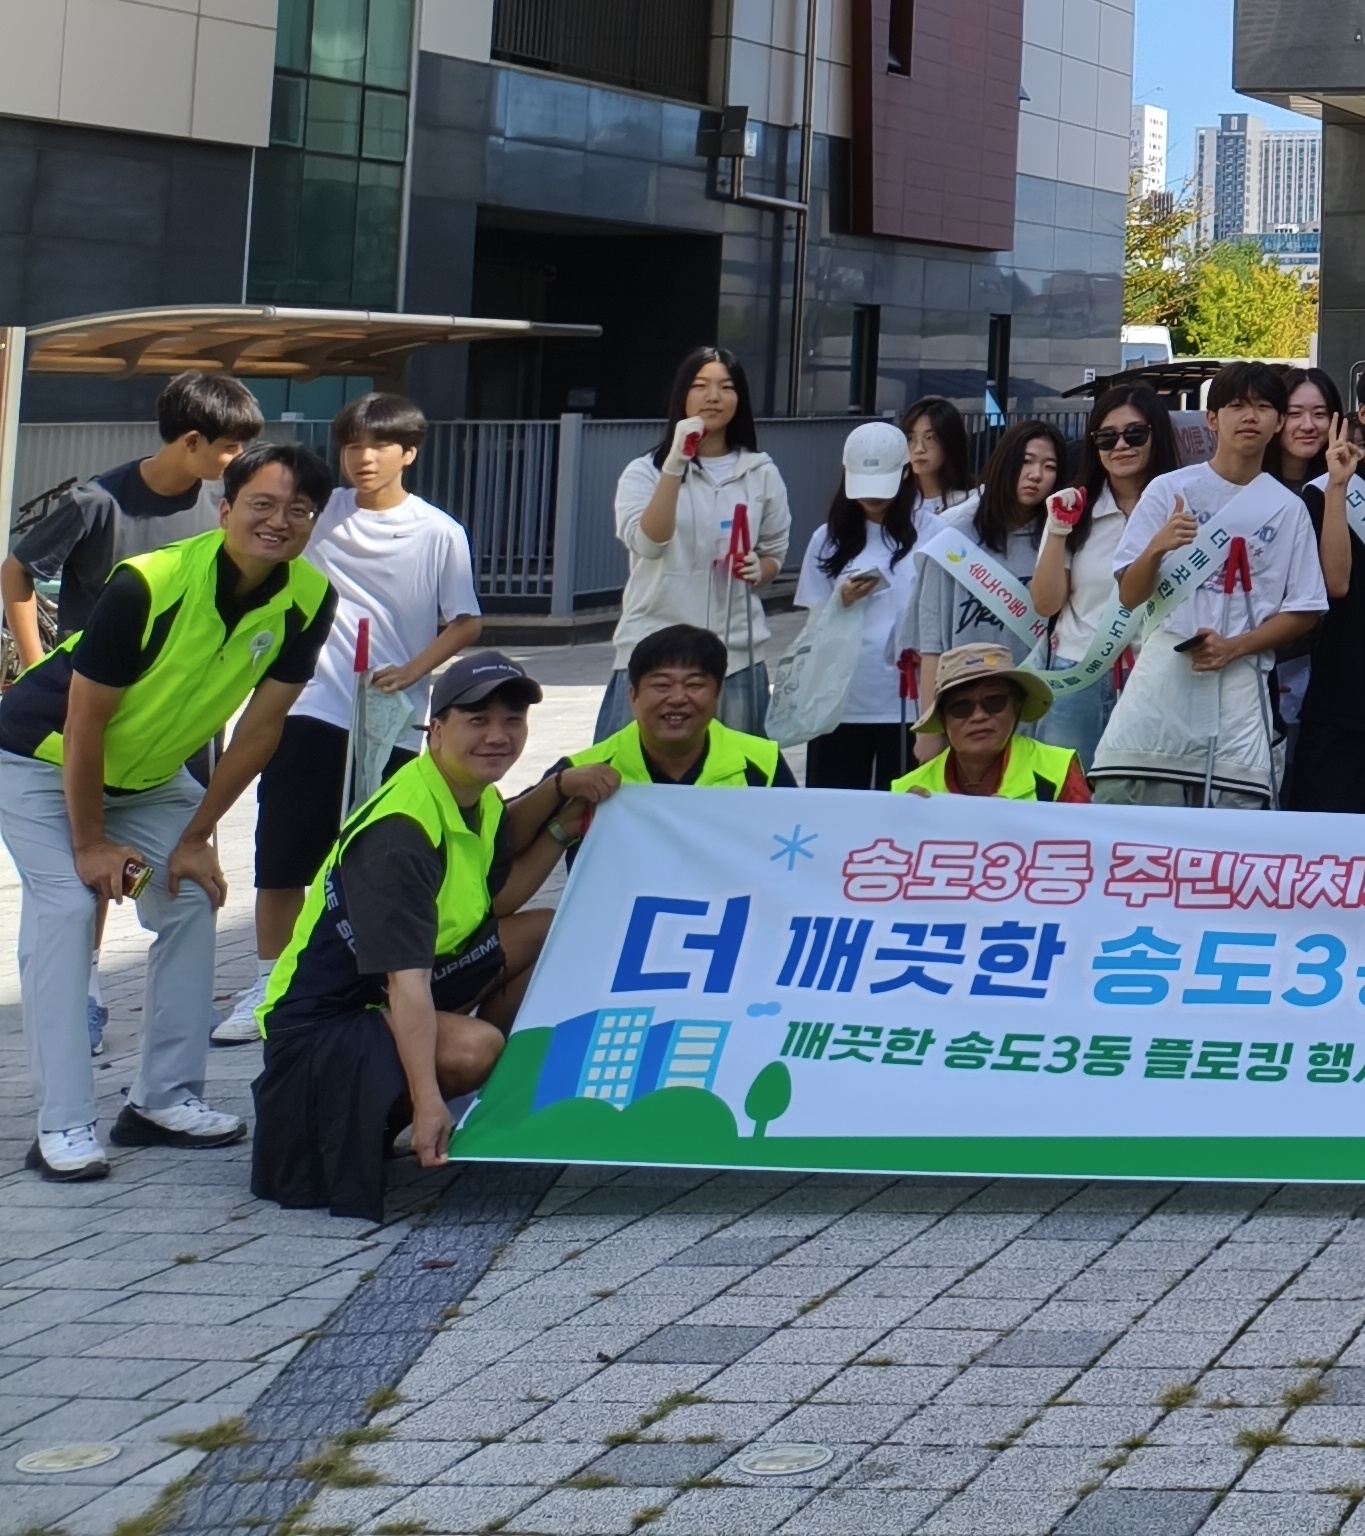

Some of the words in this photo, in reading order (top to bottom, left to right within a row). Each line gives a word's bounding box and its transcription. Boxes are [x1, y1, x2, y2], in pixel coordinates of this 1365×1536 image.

[1209, 527, 1231, 549] 더
[967, 562, 1029, 619] 송도3동
[1156, 547, 1211, 601] 깨끗한
[842, 838, 1093, 904] 송도3동
[433, 933, 500, 982] UPREME
[610, 894, 752, 994] 더
[775, 915, 1067, 999] 깨끗한
[778, 1020, 937, 1066] 깨끗한
[942, 1030, 1132, 1078] 송도3동
[1143, 1037, 1293, 1083] 플로킹
